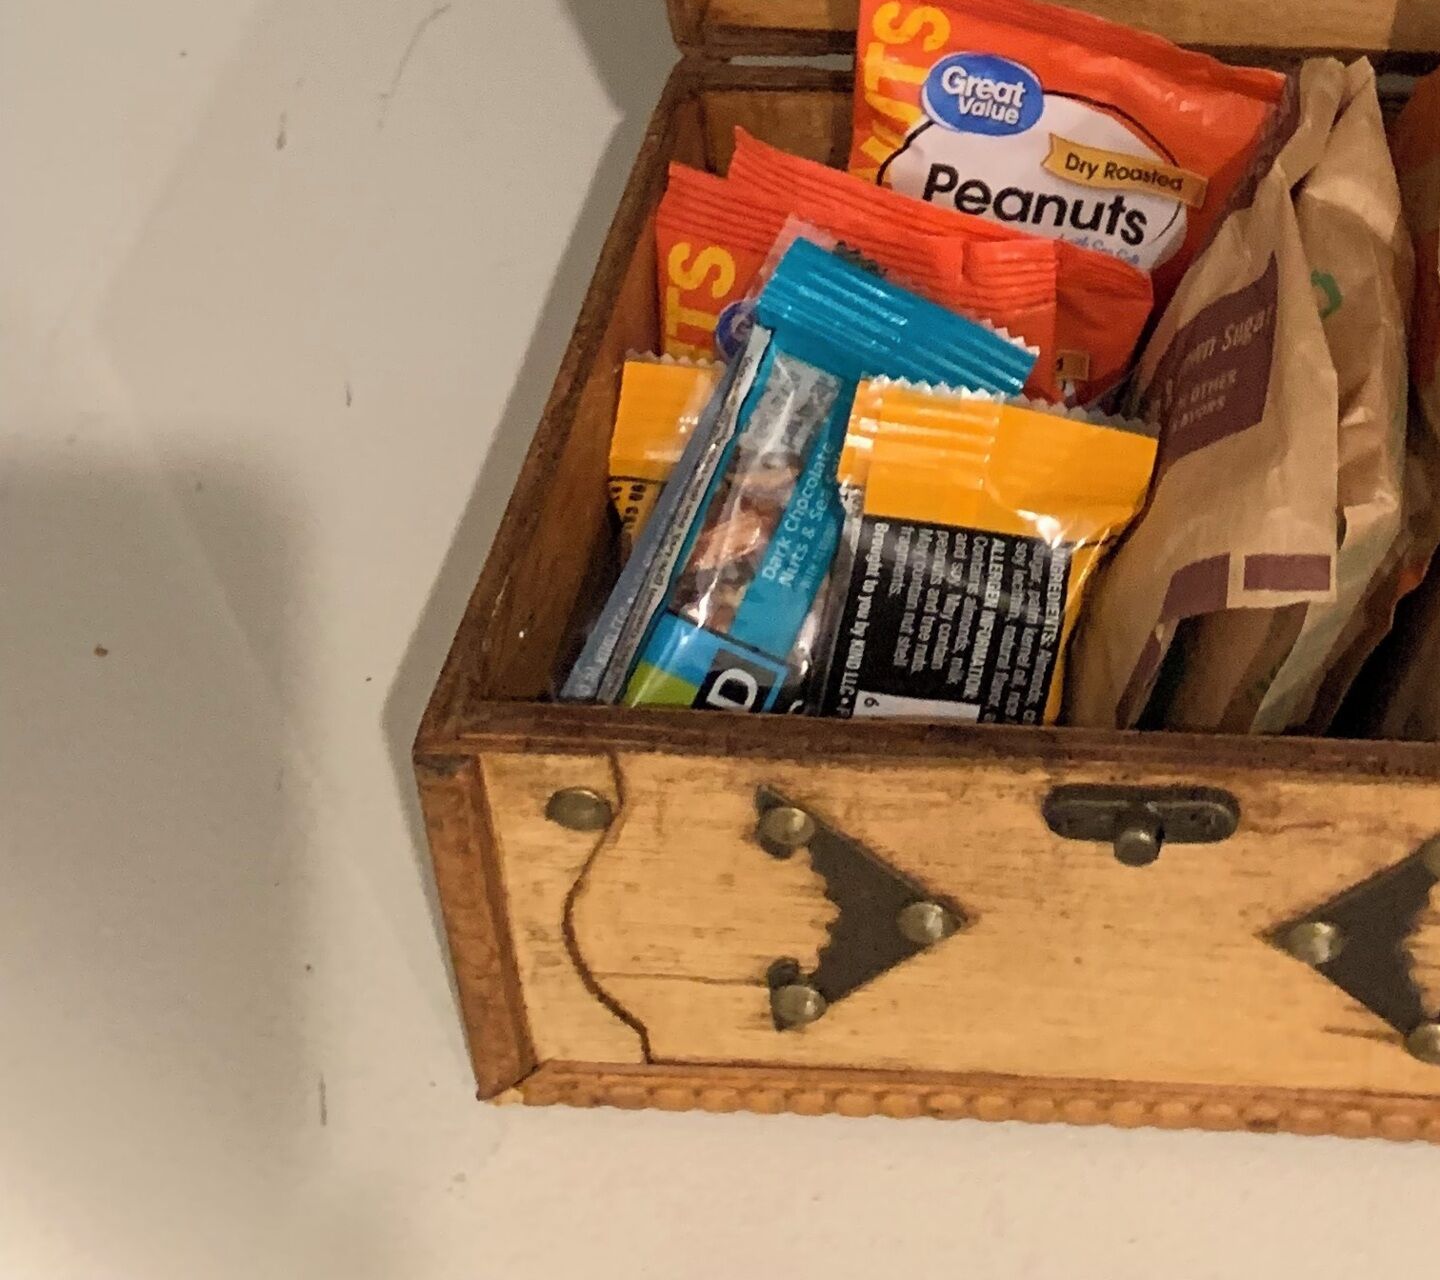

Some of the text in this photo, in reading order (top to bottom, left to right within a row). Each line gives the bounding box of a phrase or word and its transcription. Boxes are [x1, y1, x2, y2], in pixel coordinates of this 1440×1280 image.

[941, 65, 1026, 108] Great
[958, 95, 1019, 125] Value
[1064, 152, 1184, 192] Dry Roasted
[922, 163, 1147, 246] Peanuts
[761, 537, 790, 580] Dark
[784, 441, 832, 532] Chocolate
[865, 523, 888, 576] Brought
[953, 533, 967, 558] and
[778, 544, 807, 587] Nuts
[984, 539, 1004, 607] ALLERGEN
[862, 579, 877, 592] to
[923, 588, 939, 613] and
[857, 595, 871, 618] you
[850, 621, 869, 636] by
[846, 639, 864, 669] KIND
